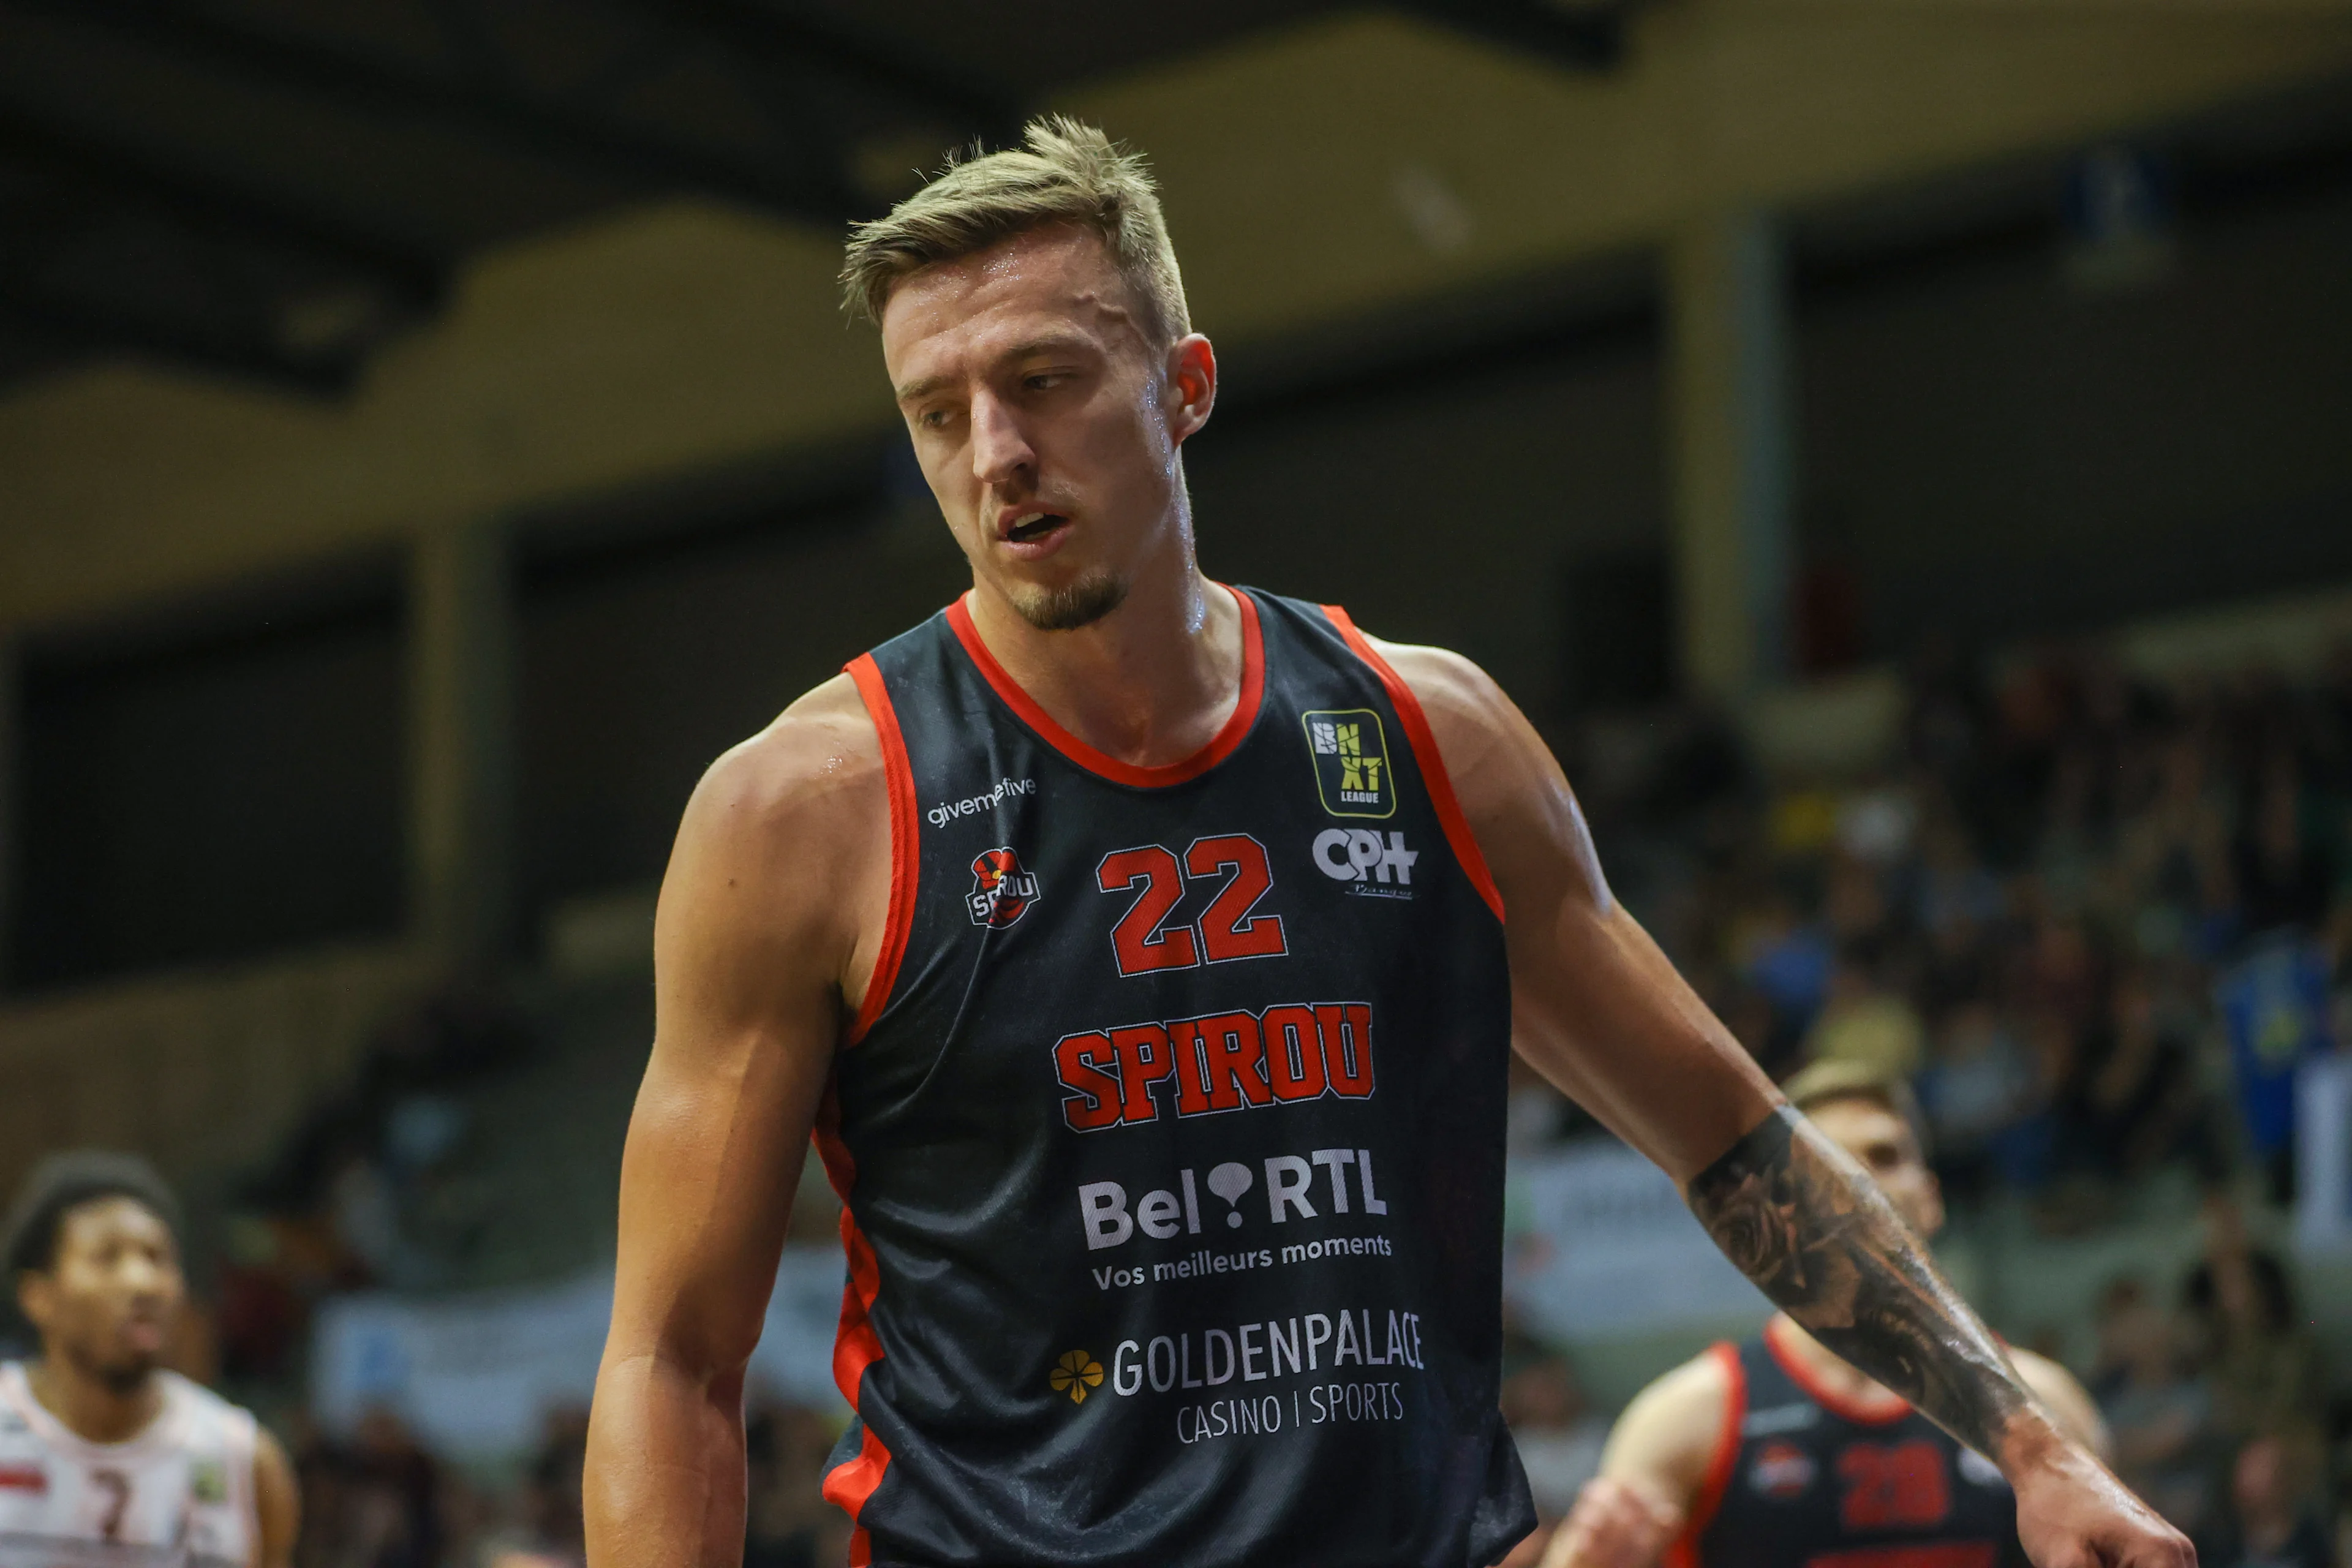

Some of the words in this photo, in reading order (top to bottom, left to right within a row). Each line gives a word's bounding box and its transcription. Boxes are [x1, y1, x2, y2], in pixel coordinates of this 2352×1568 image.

[927, 777, 1036, 829] givemefive
[1341, 791, 1379, 804] LEAGUE
[1313, 829, 1419, 885] CPH
[1095, 833, 1289, 978] 22
[1052, 1001, 1376, 1134] SPIROU
[1078, 1169, 1201, 1251] Bel
[1264, 1148, 1387, 1224] RTL
[1092, 1265, 1145, 1291] Vos
[1153, 1250, 1273, 1282] meilleurs
[1281, 1235, 1392, 1264] moments
[1113, 1309, 1425, 1396] GOLDENPALACE
[1177, 1395, 1281, 1444] CASINO
[1309, 1382, 1404, 1425] SPORTS
